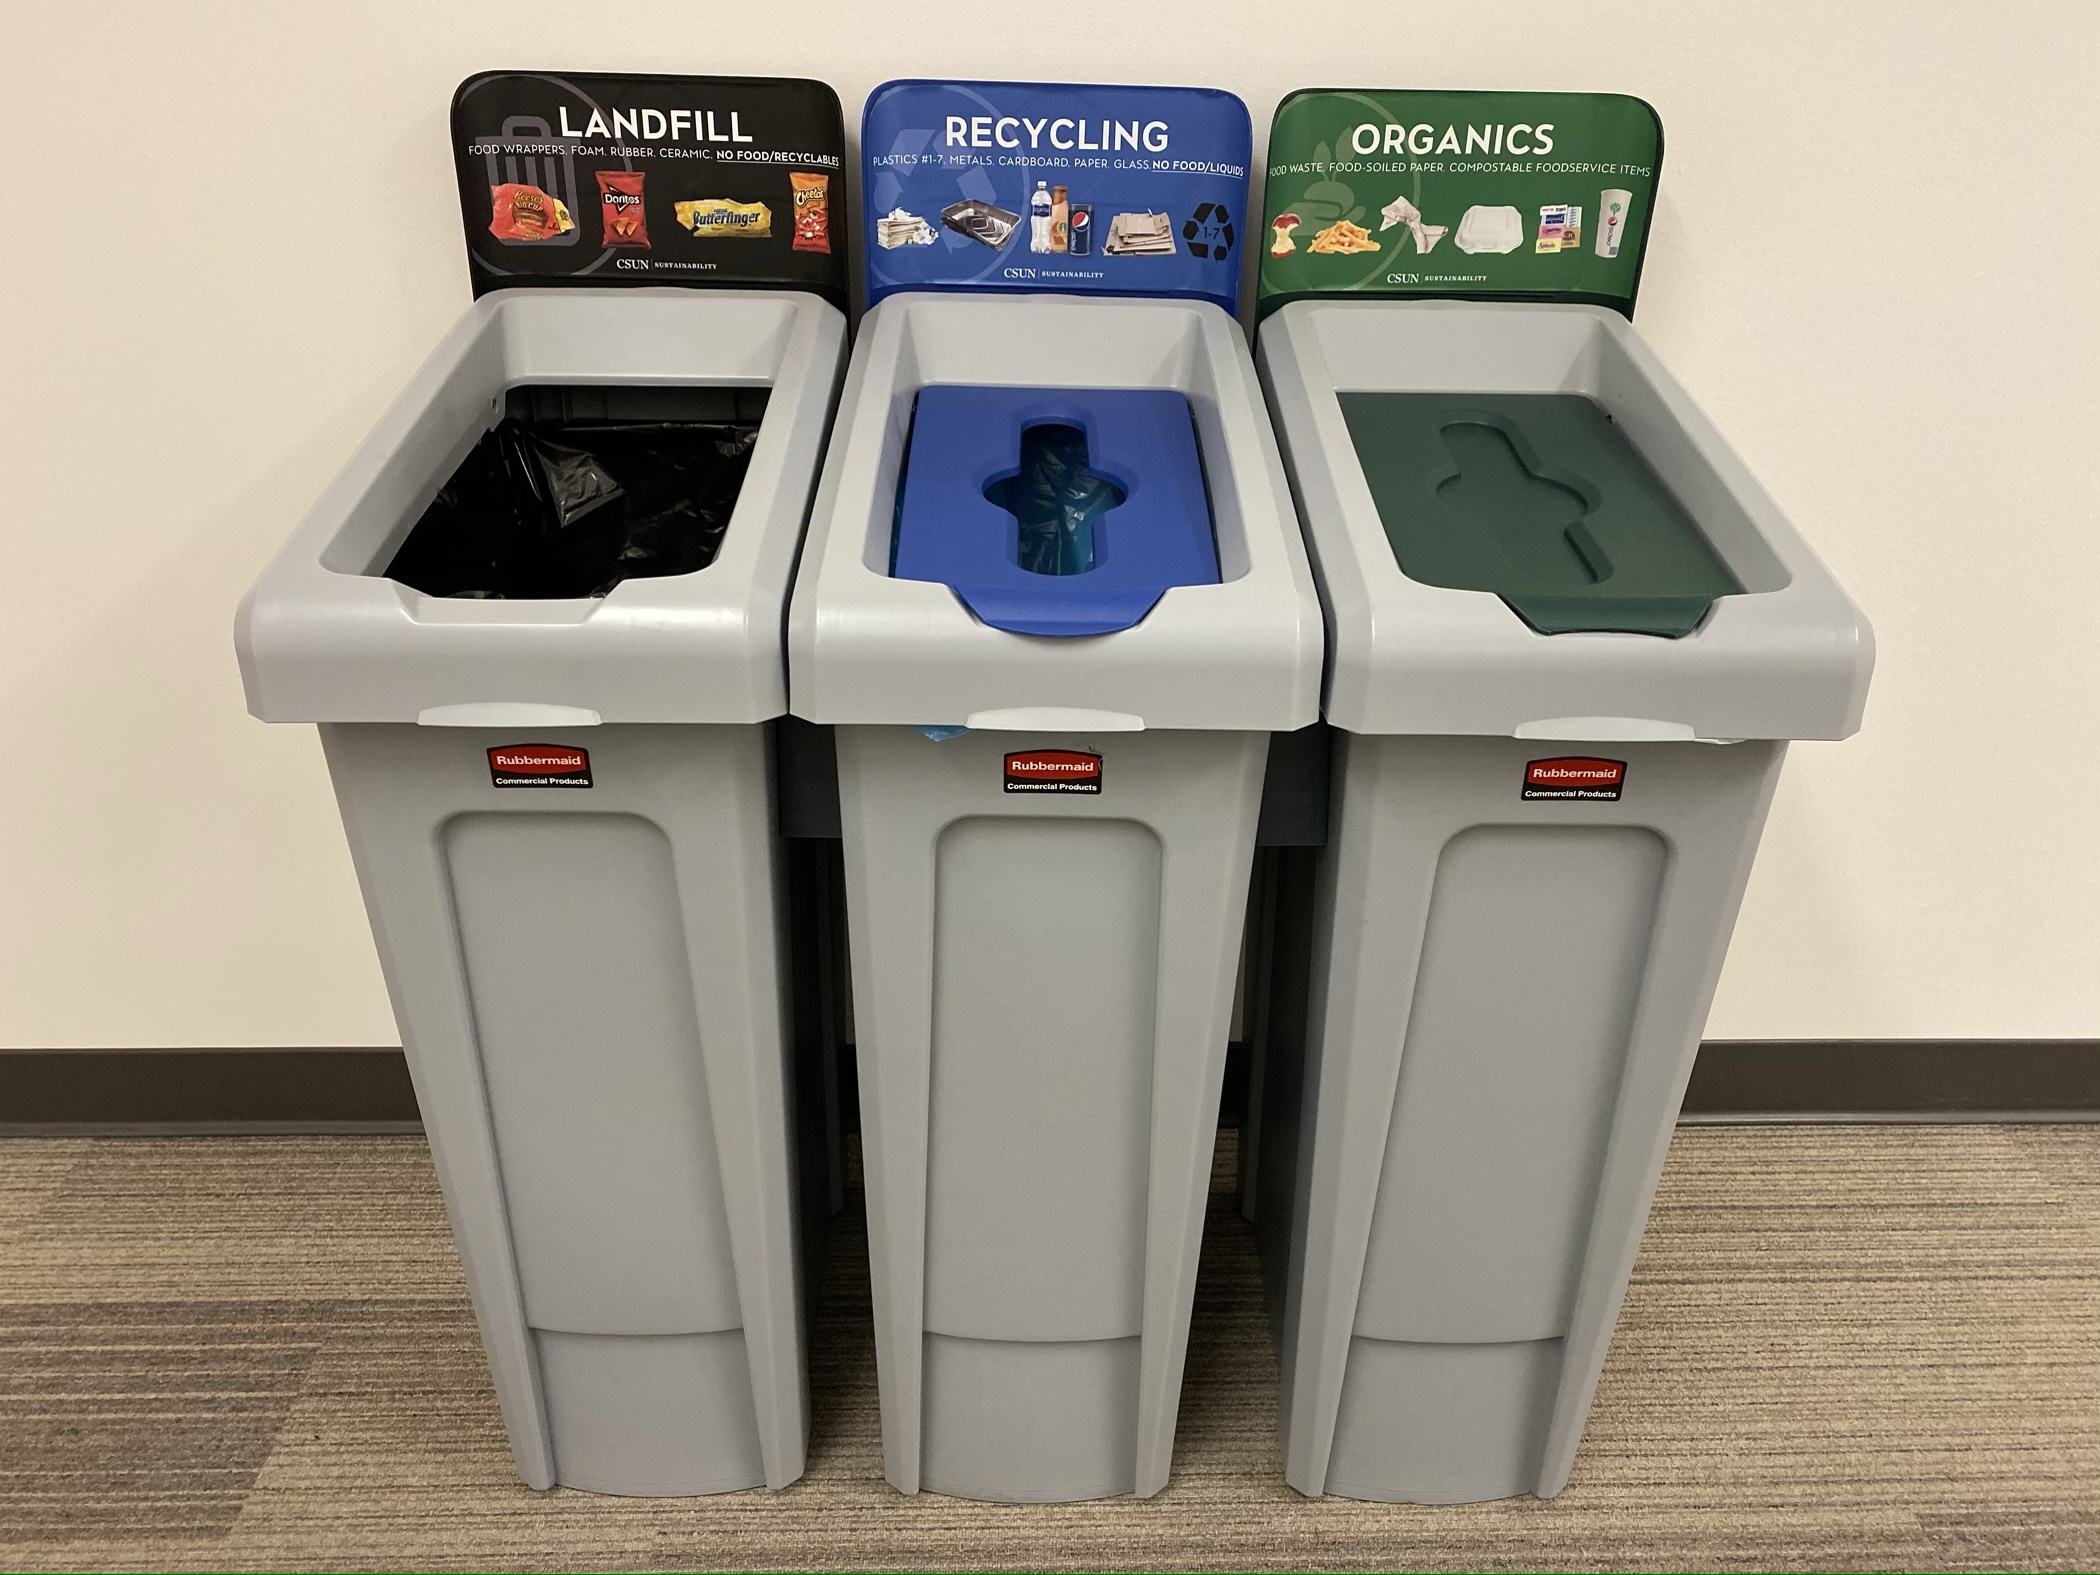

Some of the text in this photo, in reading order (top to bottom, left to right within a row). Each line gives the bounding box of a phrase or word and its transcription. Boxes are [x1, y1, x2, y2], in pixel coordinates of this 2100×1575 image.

[558, 105, 753, 143] LANDFILL
[945, 115, 1170, 152] RECYCLING
[1351, 122, 1556, 156] ORGANICS
[468, 144, 500, 156] FOOD
[716, 150, 734, 160] NO
[737, 150, 840, 167] FOOD/RECYCLABLES
[873, 154, 918, 167] PLASTICS
[1152, 160, 1170, 170] NO
[1172, 161, 1244, 177] FOOD/LIQUIDS
[1269, 165, 1287, 178] FOOD
[1329, 162, 1407, 173] FOOD-SOILED
[1449, 162, 1534, 173] COMPOSTABLE
[1535, 162, 1618, 174] FOODSERVICE
[1619, 164, 1651, 177] ITEMS
[604, 193, 641, 205] Doritos
[693, 210, 761, 227] Butterfinger
[1203, 226, 1220, 240] 1-7
[616, 258, 718, 270] CSUN SUSTAINABILITY
[1003, 267, 1104, 279] CSUN SUSTAINABILITY
[1386, 273, 1420, 284] CSUN
[496, 755, 582, 765] Rubbermaid
[1012, 761, 1094, 772] Rubbermaid
[1533, 768, 1617, 779] Rubbermaid
[495, 777, 589, 786] Commercial Products
[1059, 783, 1098, 791] Products
[1525, 790, 1617, 798] Commercial Products
